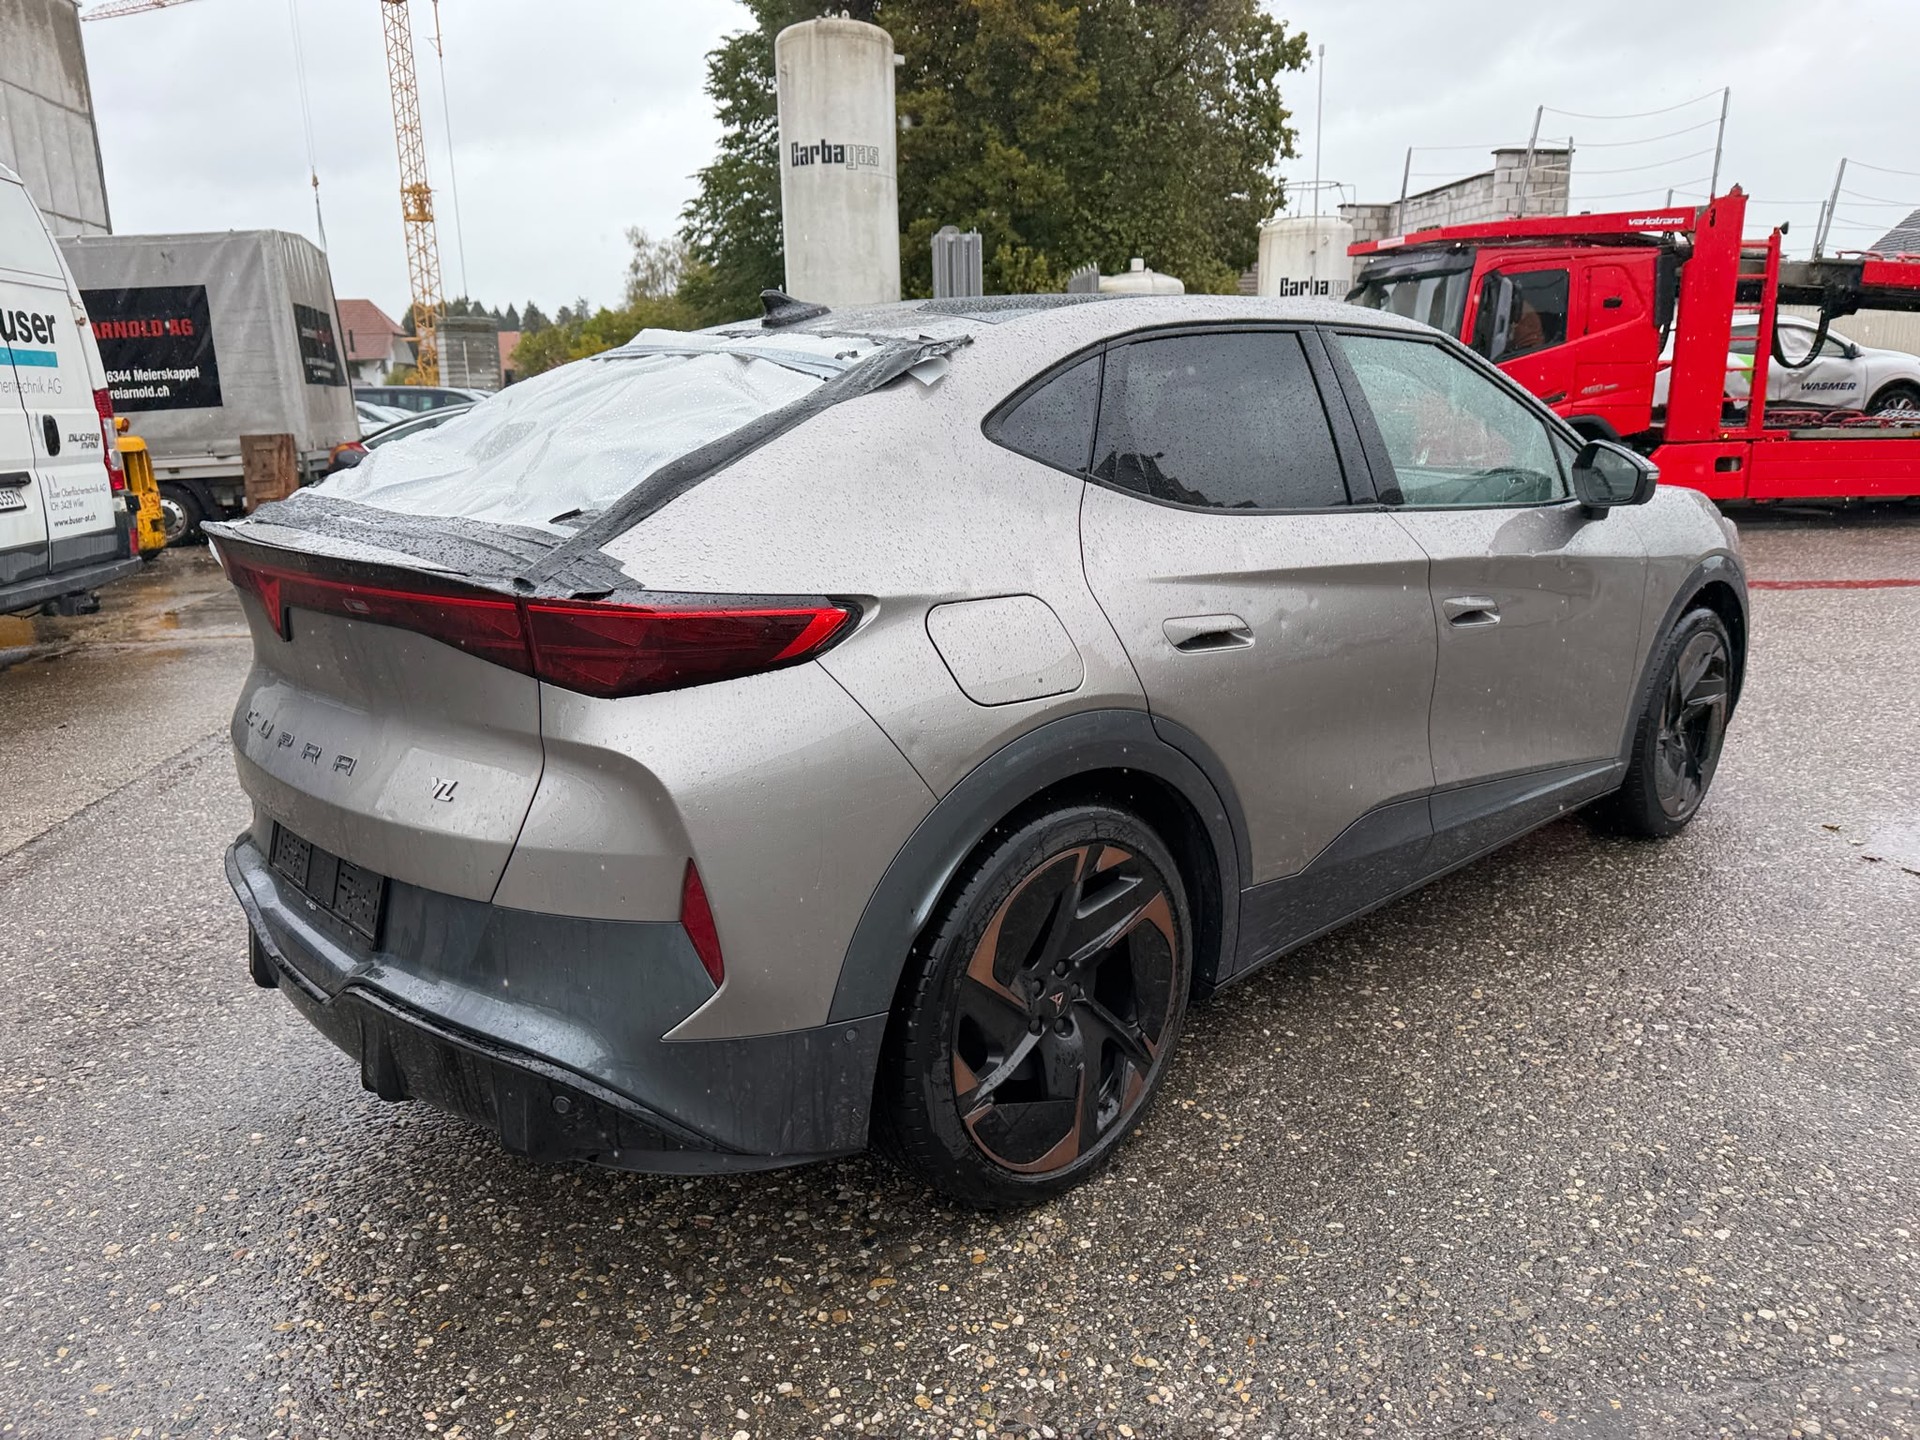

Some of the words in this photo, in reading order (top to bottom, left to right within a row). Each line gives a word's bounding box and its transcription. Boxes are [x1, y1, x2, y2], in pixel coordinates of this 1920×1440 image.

[791, 139, 880, 170] Carbagas
[1628, 217, 1685, 226] variotrans
[168, 318, 194, 336] AG
[106, 370, 131, 383] 6344
[133, 366, 200, 382] Meierskappel
[47, 377, 62, 395] AG
[1801, 382, 1857, 391] WASMER
[246, 710, 358, 777] CUPRA
